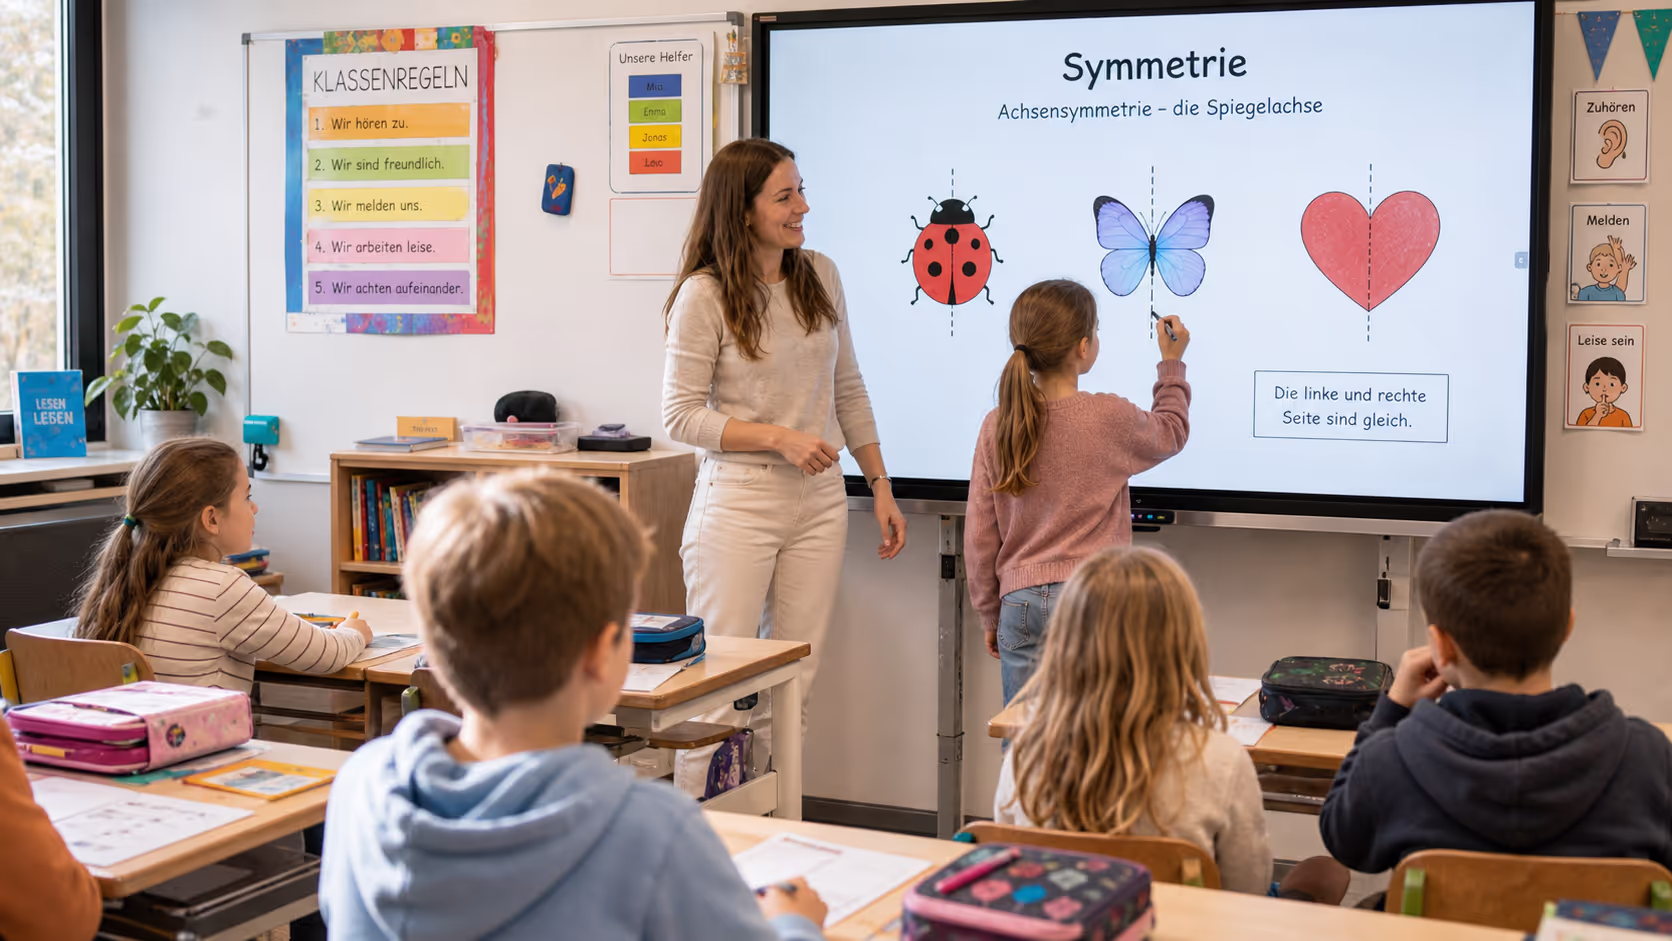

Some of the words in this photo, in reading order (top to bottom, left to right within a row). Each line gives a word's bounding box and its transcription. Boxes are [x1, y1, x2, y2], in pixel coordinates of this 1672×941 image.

[619, 52, 656, 64] Unsere
[659, 50, 694, 63] Helfer
[1062, 47, 1248, 90] Symmetrie
[313, 64, 468, 93] KLASSENREGELN
[646, 82, 664, 92] Mia
[997, 100, 1153, 124] Achsensymmetrie
[1172, 98, 1200, 117] die
[1206, 95, 1323, 121] Spiegelachse
[1586, 101, 1636, 114] Zuhören
[314, 118, 325, 131] 1.
[331, 117, 352, 130] Wir
[355, 116, 388, 130] hören
[391, 119, 409, 129] zu.
[642, 133, 668, 143] Jonas
[314, 158, 326, 172] 2.
[331, 158, 352, 171] Wir
[356, 158, 380, 171] sind
[384, 156, 445, 171] freundlich.
[314, 199, 326, 212] 3.
[331, 200, 352, 212] Wir
[356, 198, 396, 212] melden
[400, 201, 423, 212] uns.
[1586, 214, 1630, 226] Melden
[314, 241, 326, 253] 4.
[331, 240, 353, 253] Wir
[355, 240, 403, 254] arbeiten
[407, 240, 436, 253] leise.
[314, 280, 326, 294] 5.
[331, 281, 353, 294] Wir
[355, 280, 392, 294] achten
[395, 280, 464, 295] aufeinander.
[1577, 334, 1608, 346] Leise
[1611, 335, 1635, 346] sein
[1274, 385, 1298, 401] Die
[1304, 385, 1339, 402] linke
[1344, 386, 1372, 403] und
[1378, 387, 1427, 404] rechte
[35, 398, 66, 410] LESEN
[1282, 410, 1321, 427] Seite
[1326, 410, 1357, 427] sind
[1363, 412, 1413, 431] gleich.
